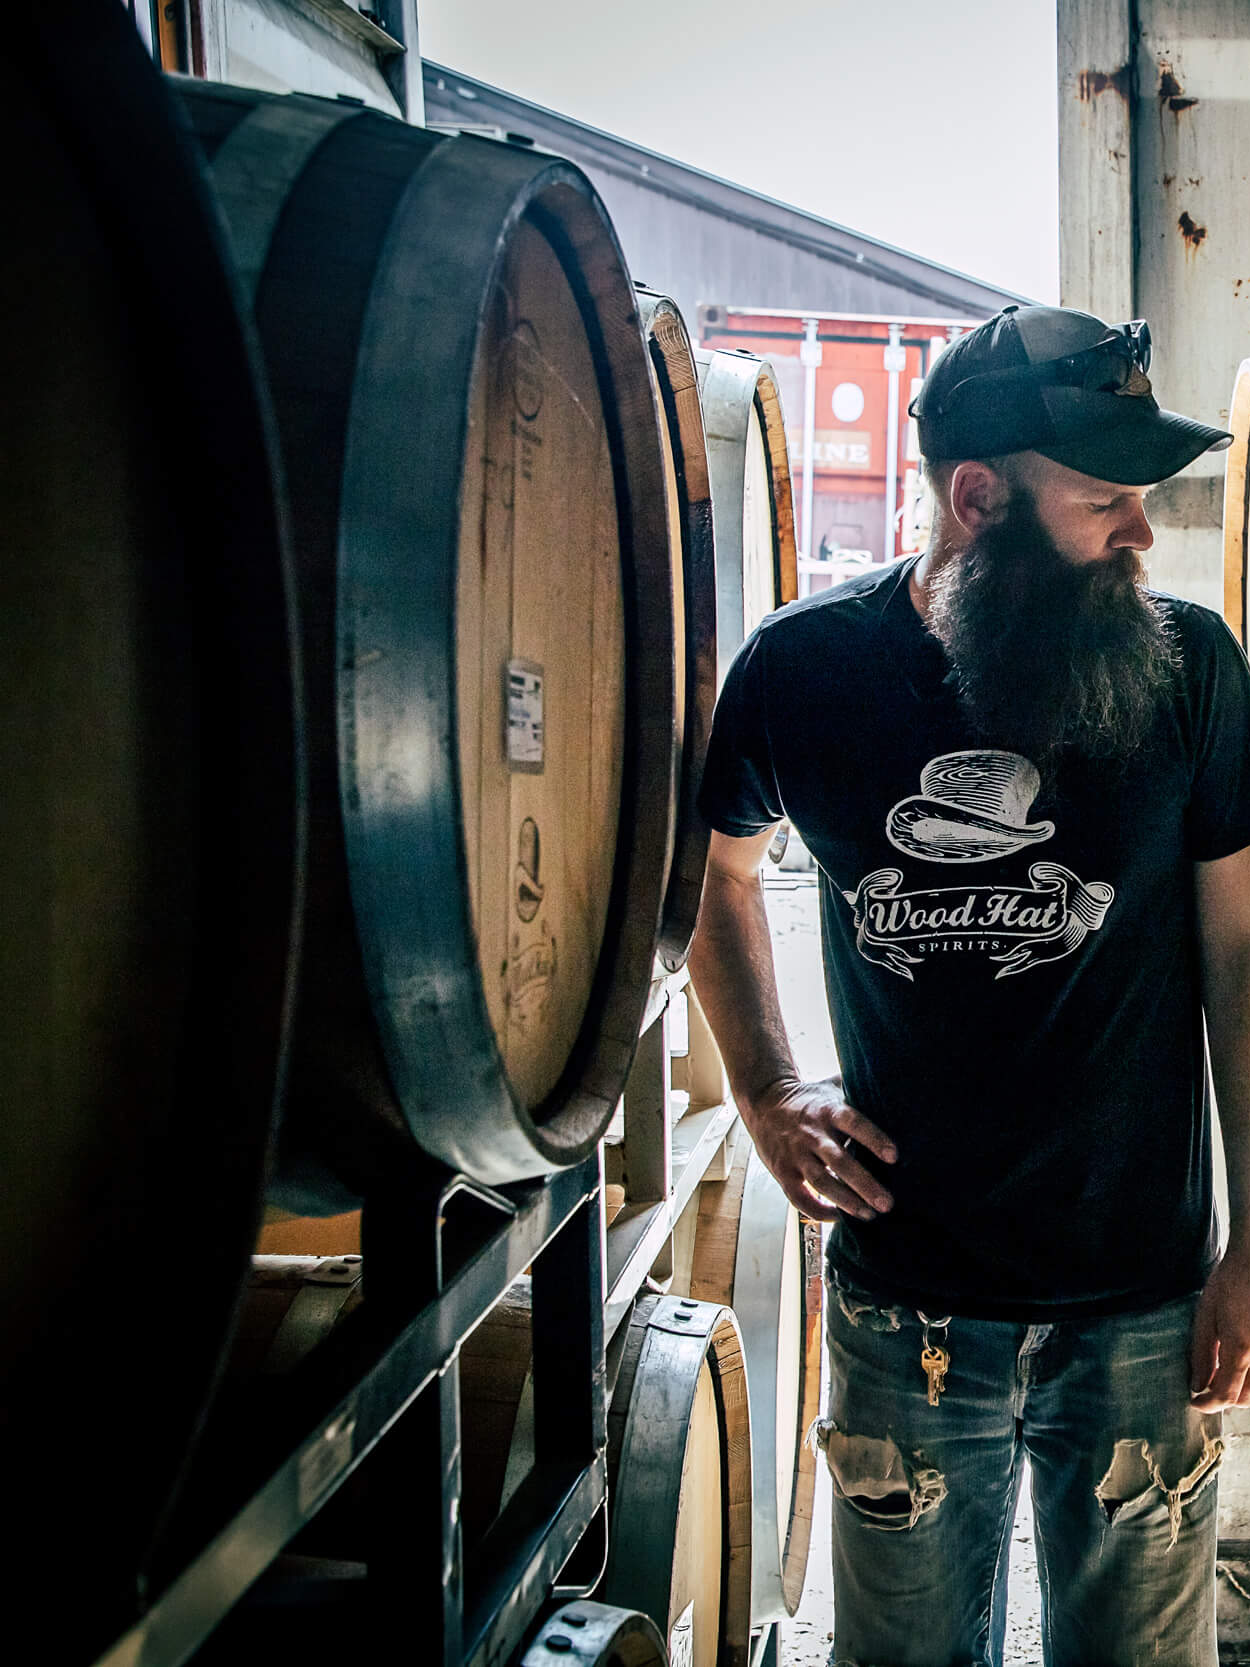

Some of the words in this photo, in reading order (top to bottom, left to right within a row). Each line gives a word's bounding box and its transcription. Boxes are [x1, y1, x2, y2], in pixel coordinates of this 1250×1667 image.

[869, 895, 975, 933] Wood
[978, 894, 1058, 928] Hat
[918, 940, 1001, 952] SPIRITS
